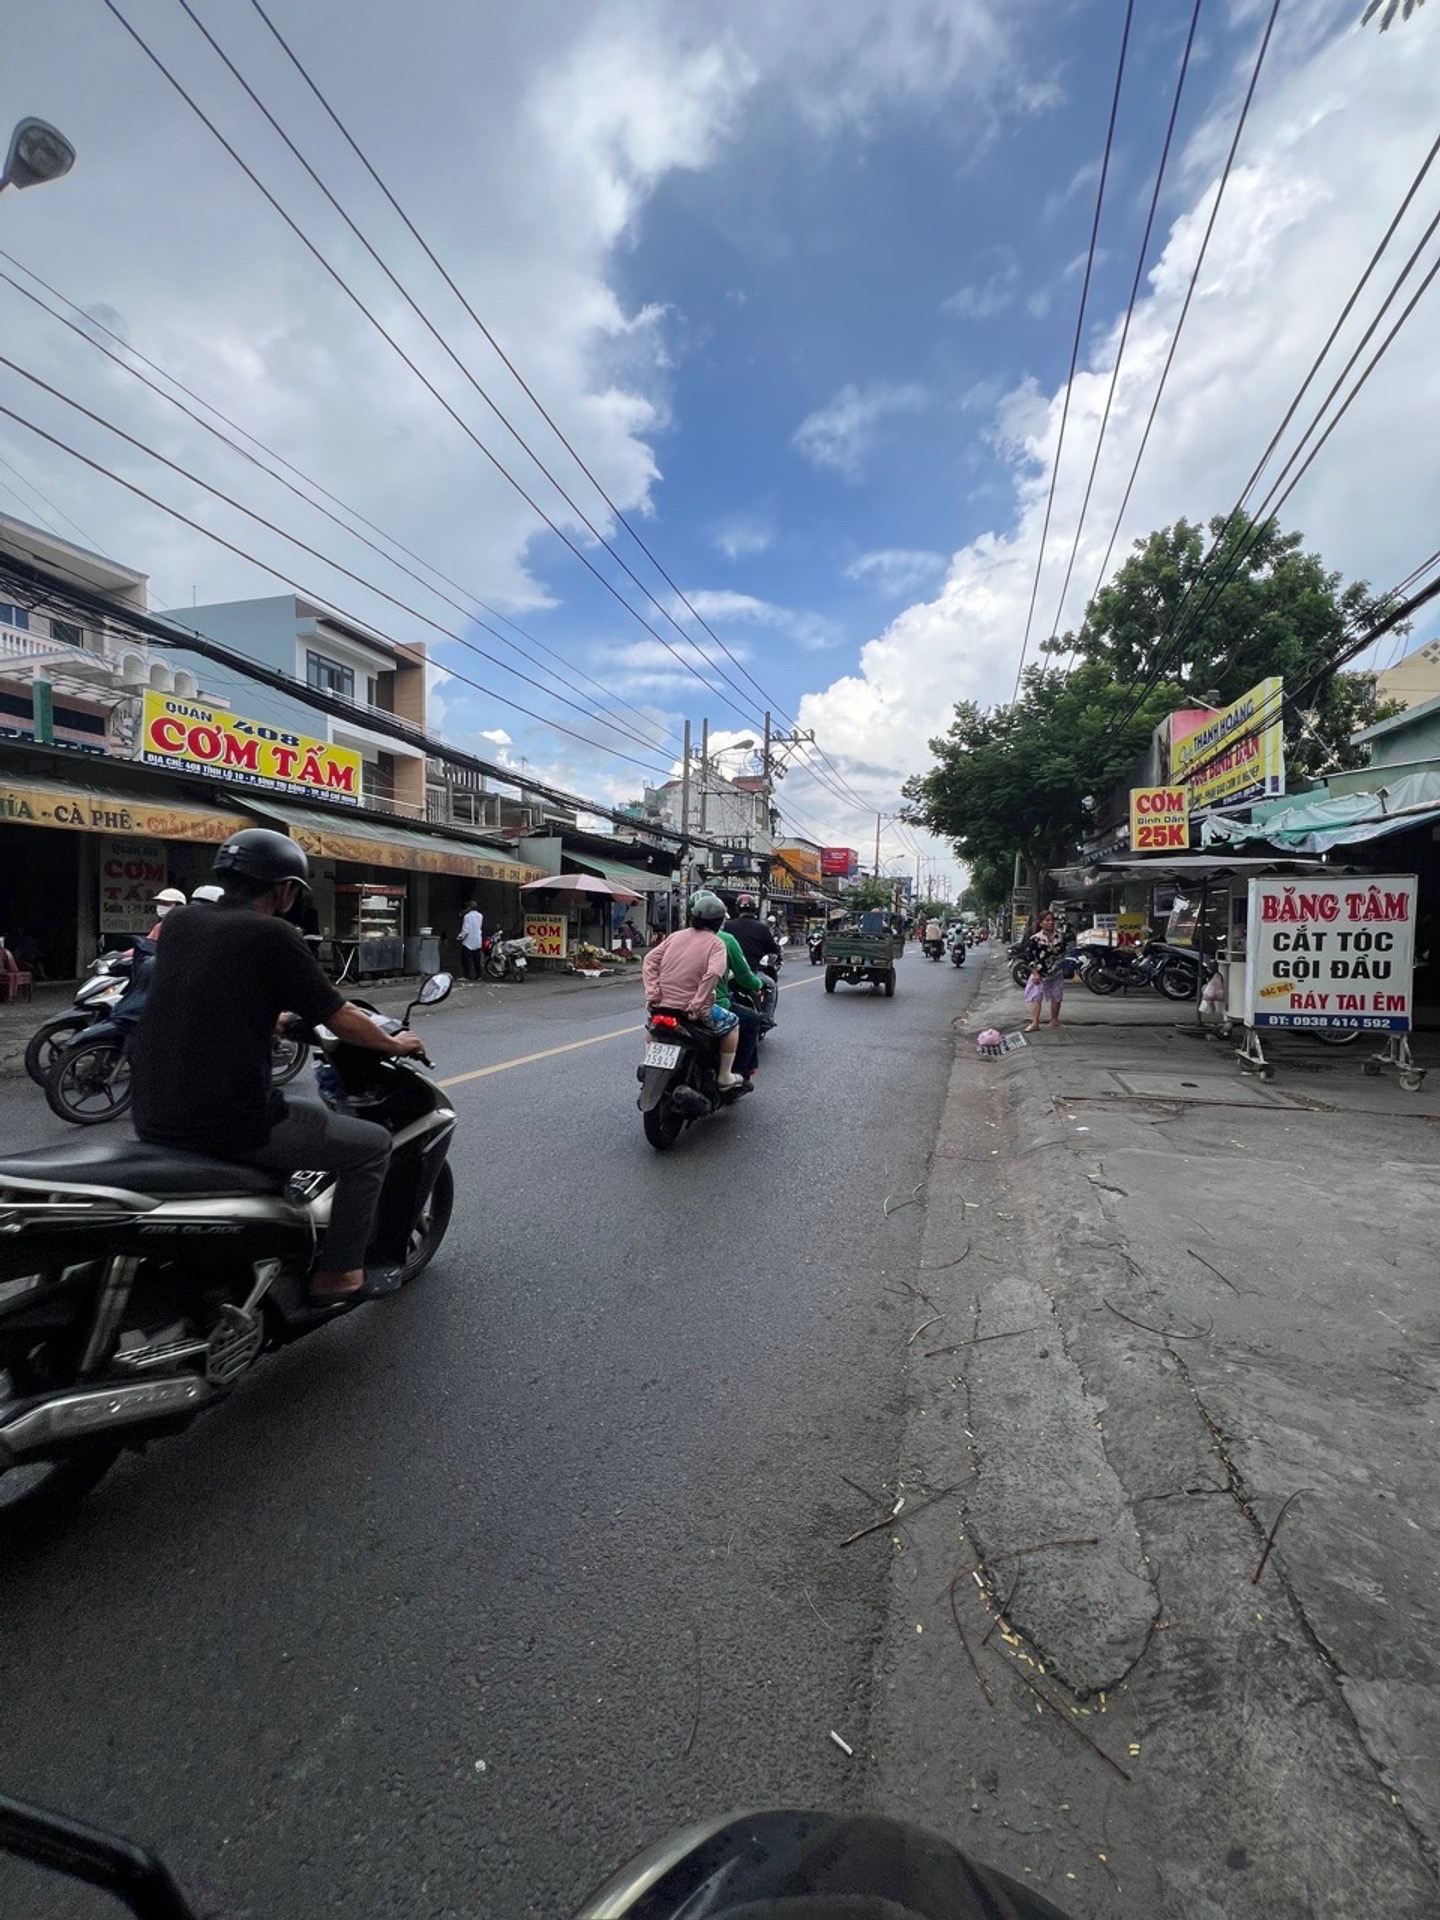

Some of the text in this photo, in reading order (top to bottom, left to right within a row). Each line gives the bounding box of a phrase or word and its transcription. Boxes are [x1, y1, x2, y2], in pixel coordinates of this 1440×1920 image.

[165, 701, 212, 723] QUÁN
[232, 720, 300, 747] 408
[1194, 722, 1219, 751] THANH
[1219, 698, 1254, 738] HOÀNG
[150, 716, 354, 792] CƠM TẤM
[235, 772, 244, 780] 10
[1136, 789, 1184, 814] CƠM
[54, 802, 85, 825] CÀ
[91, 808, 132, 830] PHÊ
[1138, 824, 1185, 847] 25K
[104, 859, 165, 881] CƠM
[1262, 884, 1410, 923] BĂNG TÂM
[526, 923, 561, 937] CƠM
[1272, 924, 1393, 952] CẮT TÓC
[534, 937, 561, 955] ẤM
[1272, 956, 1320, 983] GỘI
[1289, 990, 1406, 1012] RÁY TAI ÊM
[1293, 1016, 1328, 1026] 0938
[1332, 1017, 1359, 1027] 414
[1363, 1018, 1391, 1029] 592
